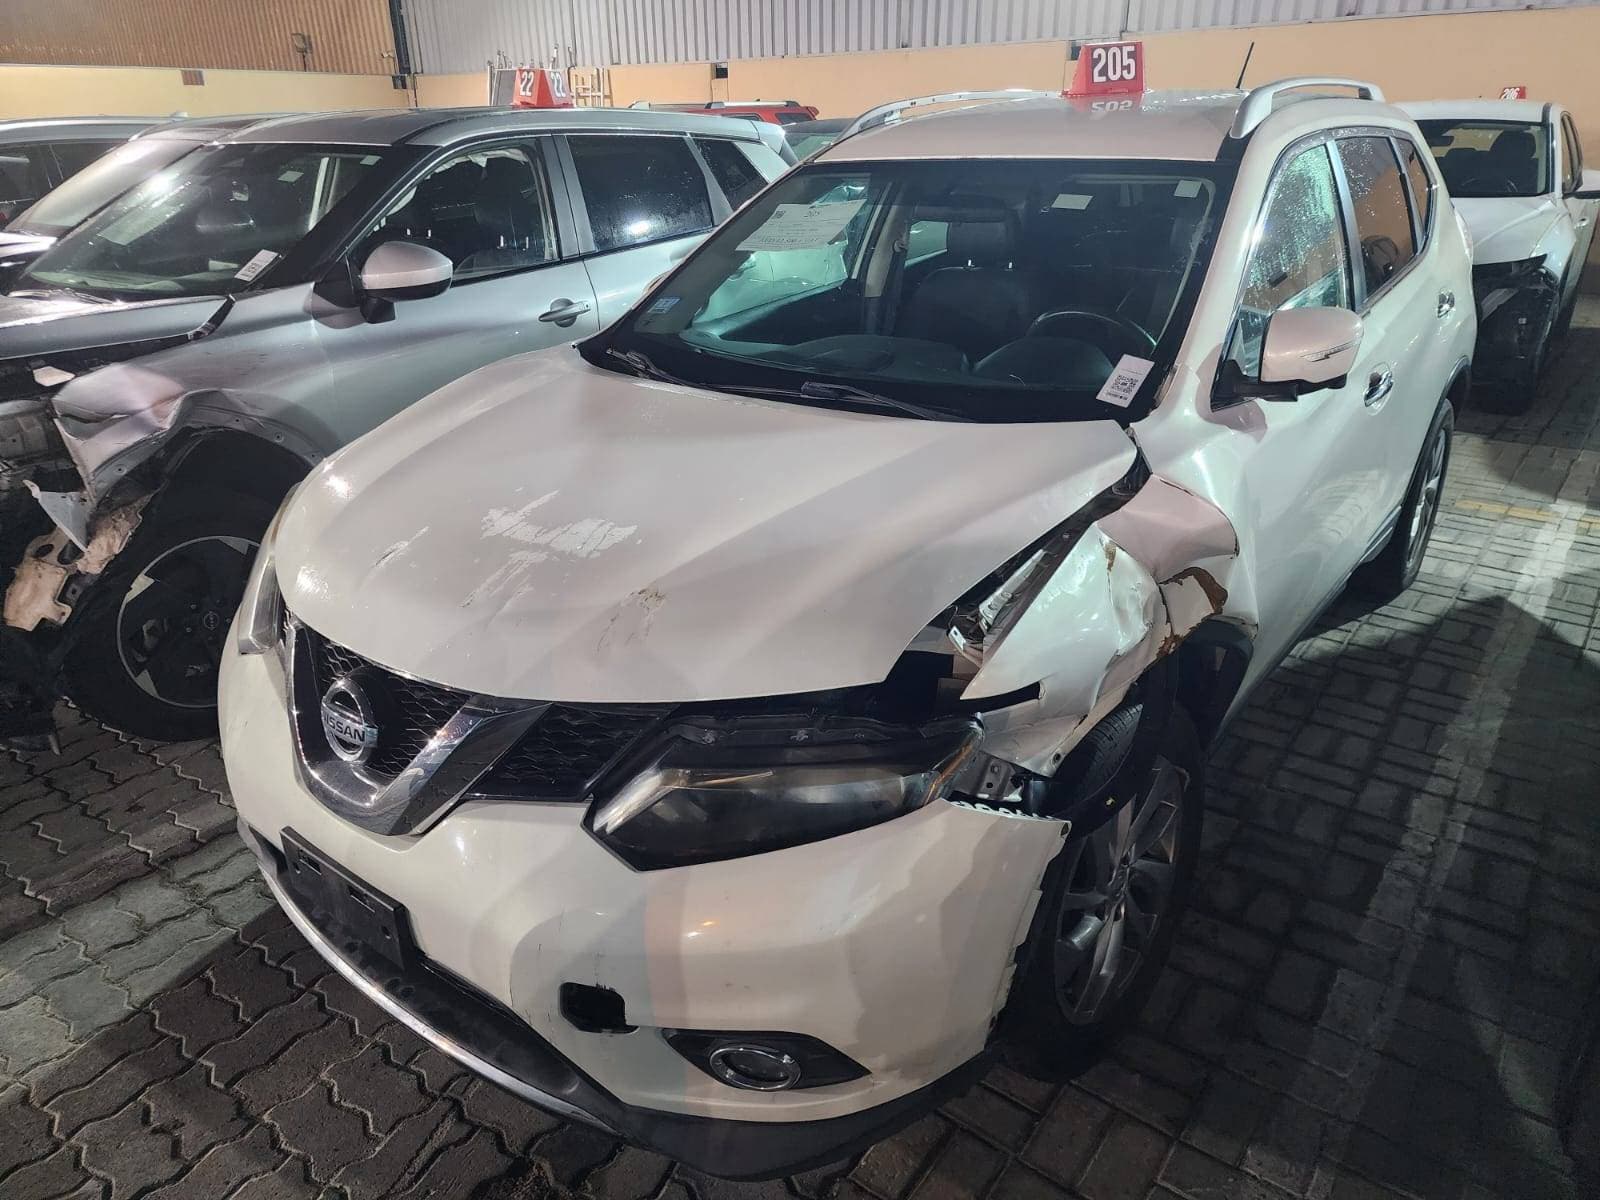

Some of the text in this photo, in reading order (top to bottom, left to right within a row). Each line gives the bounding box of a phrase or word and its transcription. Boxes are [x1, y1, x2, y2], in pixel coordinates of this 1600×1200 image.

[1092, 45, 1136, 83] 205
[520, 71, 534, 97] 22
[550, 71, 567, 98] 22
